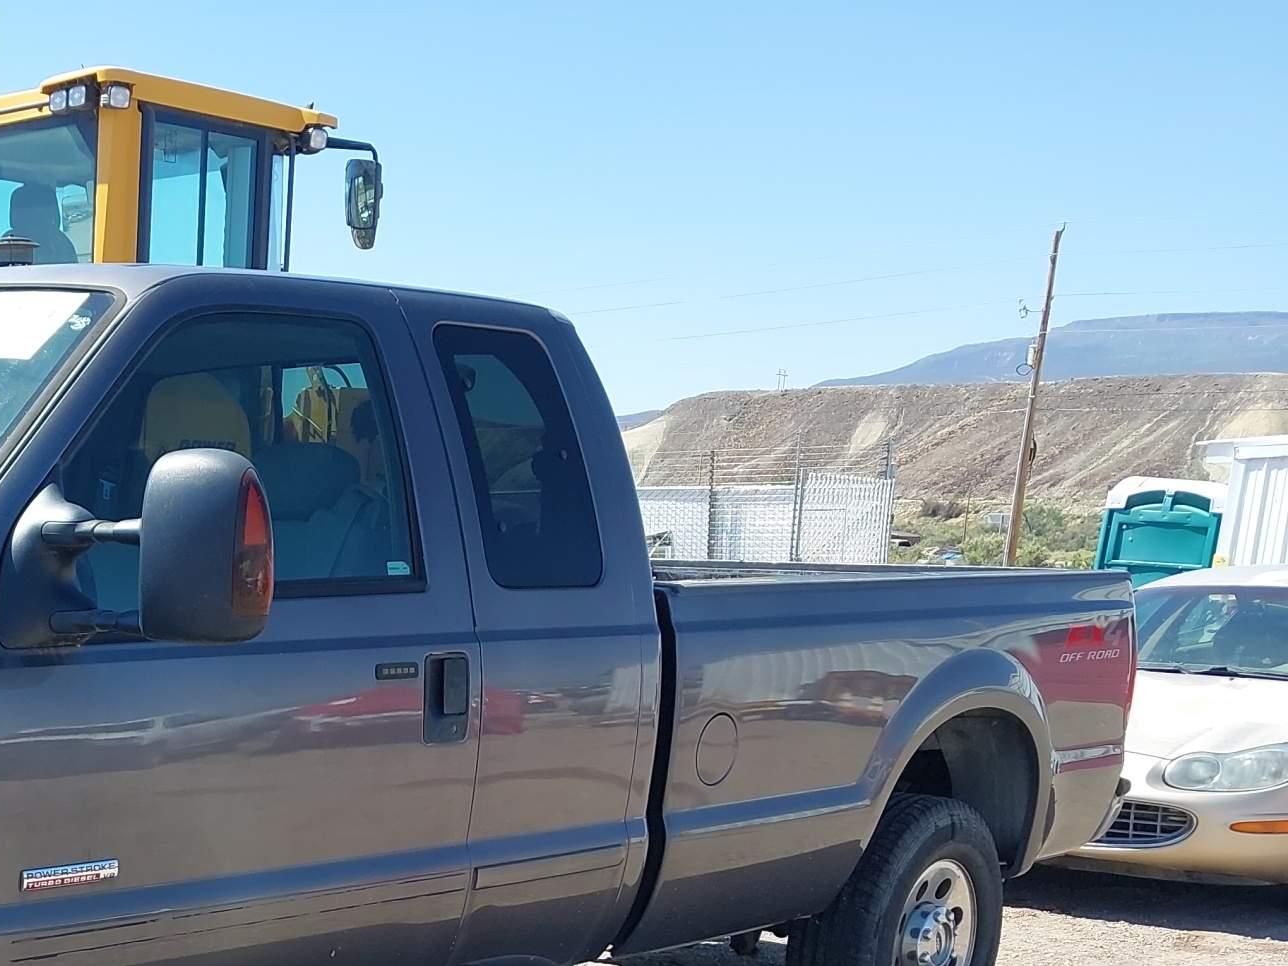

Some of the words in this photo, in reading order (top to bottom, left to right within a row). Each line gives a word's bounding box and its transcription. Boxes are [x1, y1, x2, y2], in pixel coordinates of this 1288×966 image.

[1059, 652, 1085, 663] OFF
[1087, 649, 1121, 661] ROAD
[28, 879, 61, 888] TURBO
[64, 875, 99, 884] DIESEL
[103, 871, 116, 880] V8
